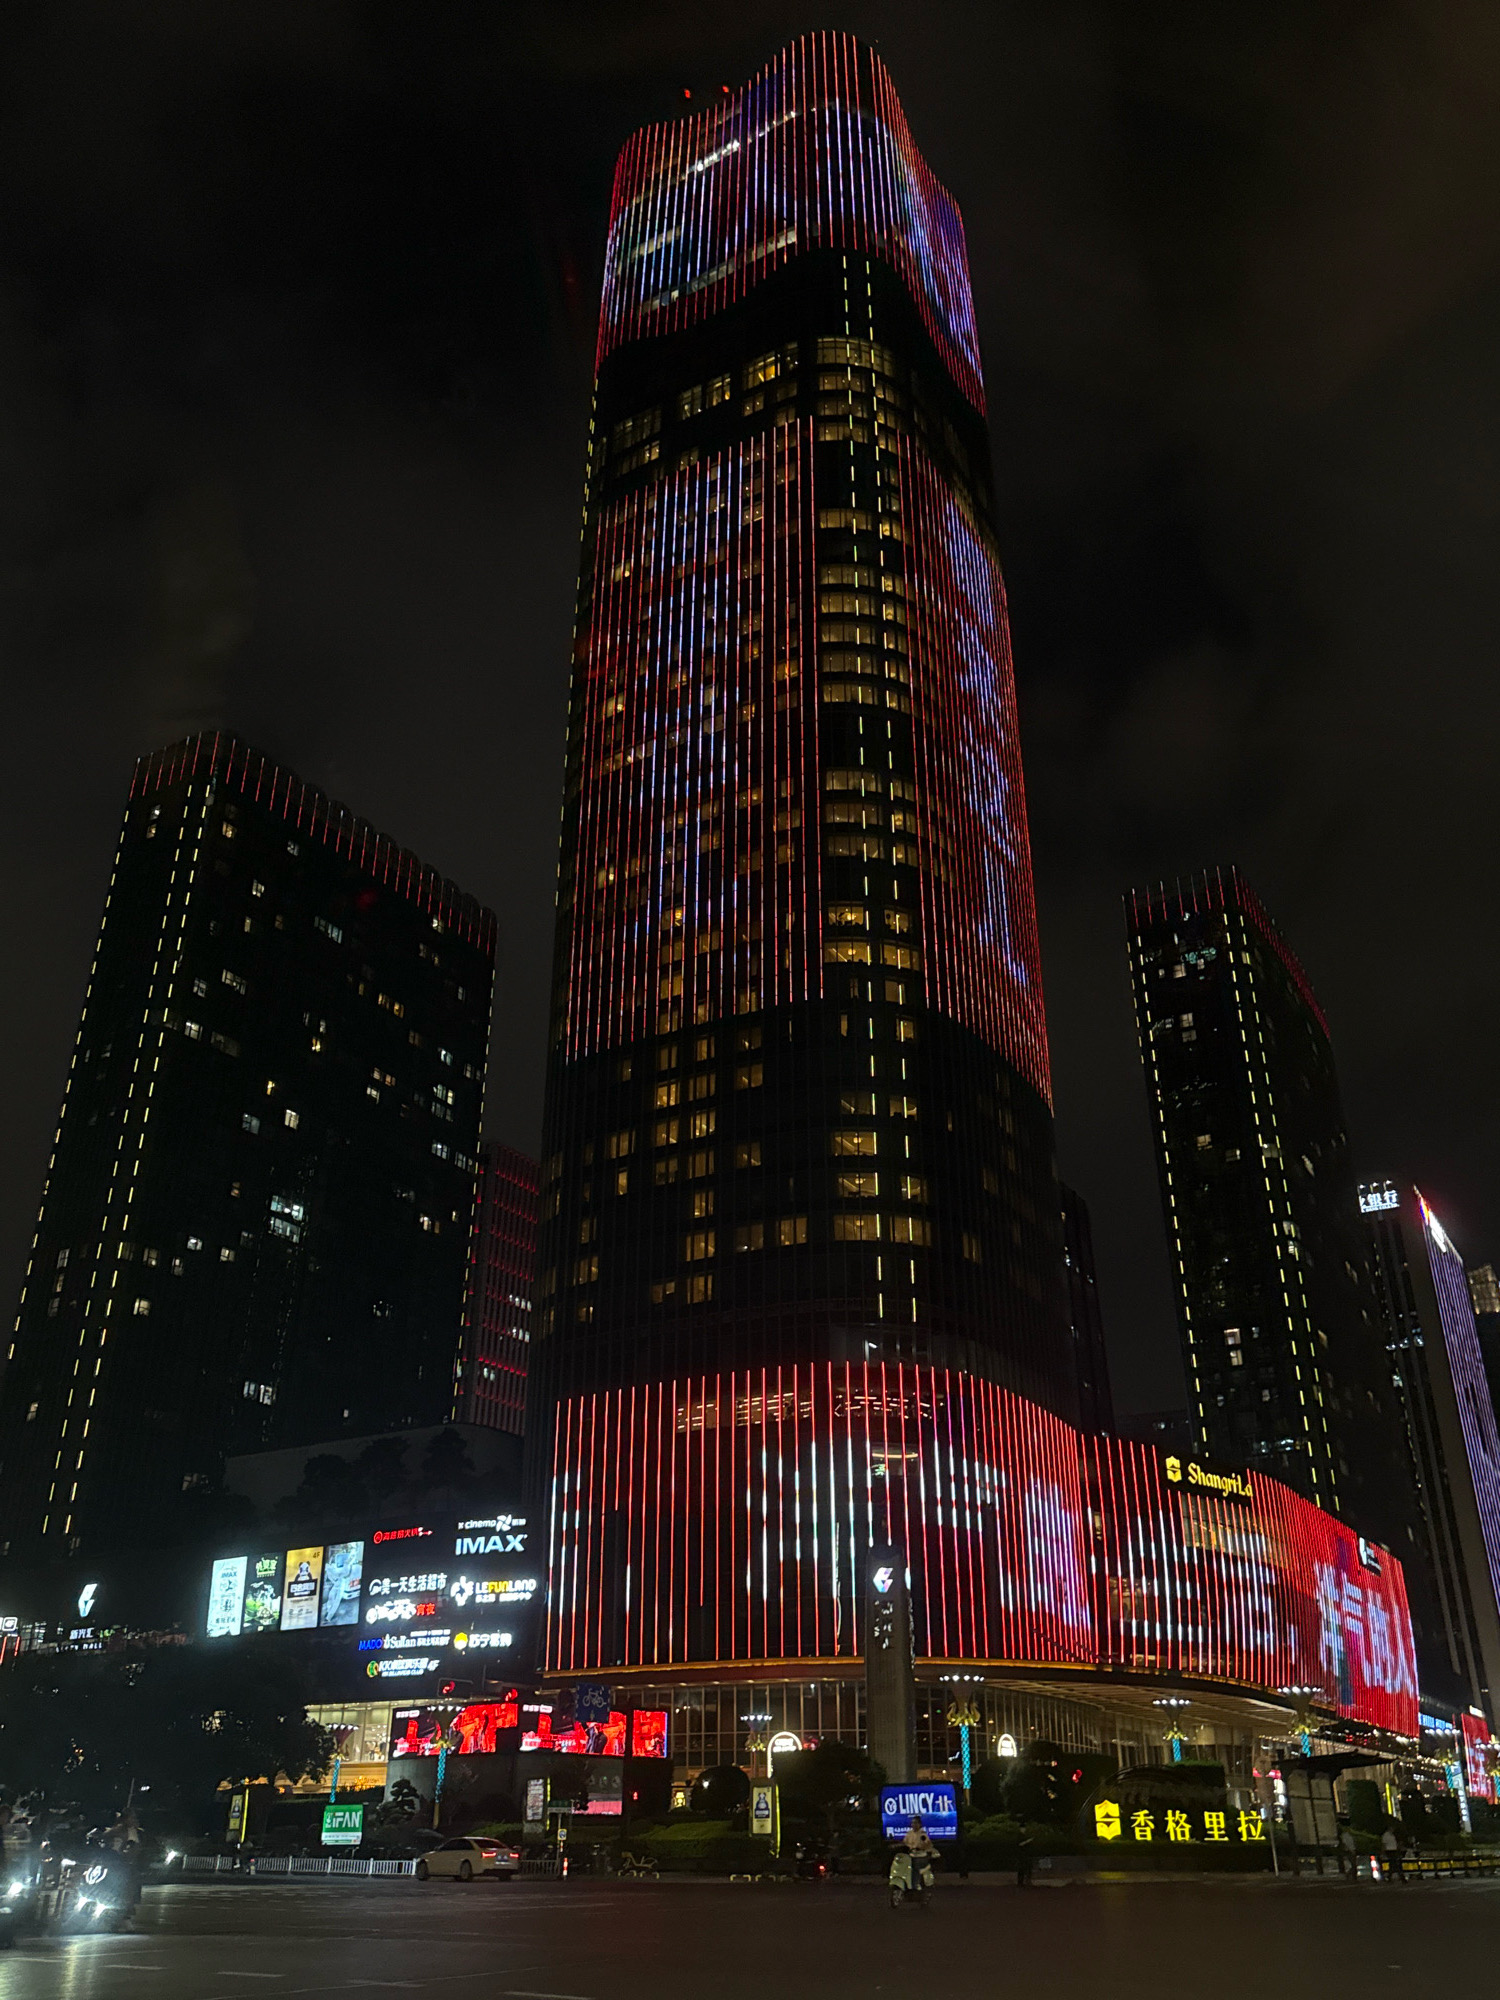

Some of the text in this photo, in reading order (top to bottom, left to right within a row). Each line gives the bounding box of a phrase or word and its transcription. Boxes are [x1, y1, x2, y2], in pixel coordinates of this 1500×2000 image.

[456, 1535, 524, 1555] IMAX
[899, 1793, 934, 1814] LINCY
[1130, 1809, 1266, 1842] 香格里拉
